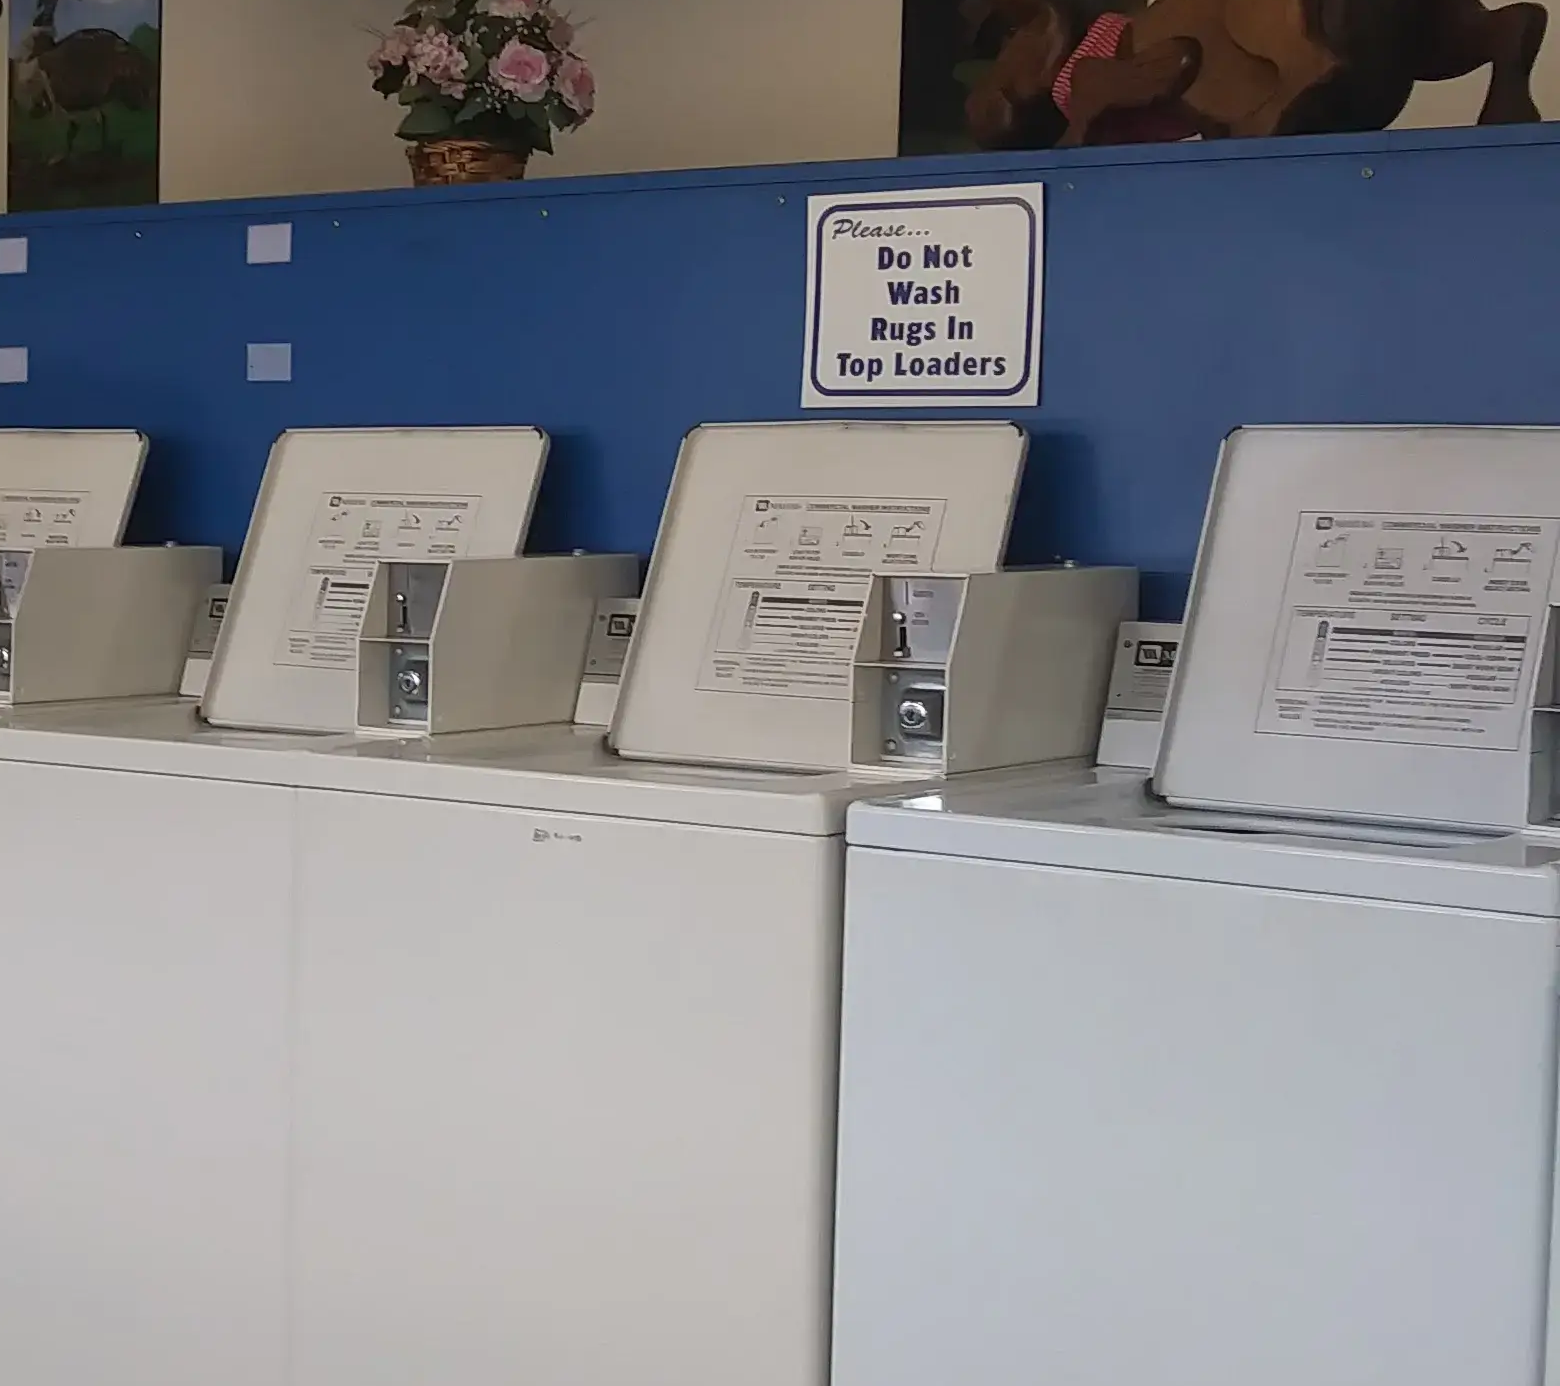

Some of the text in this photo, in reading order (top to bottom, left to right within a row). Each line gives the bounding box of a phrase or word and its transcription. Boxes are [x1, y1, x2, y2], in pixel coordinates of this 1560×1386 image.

[832, 218, 930, 240] Please...
[877, 244, 973, 270] Do Not
[887, 279, 960, 305] Wash
[870, 315, 974, 346] Rugs In
[836, 351, 1006, 382] Top Loaders
